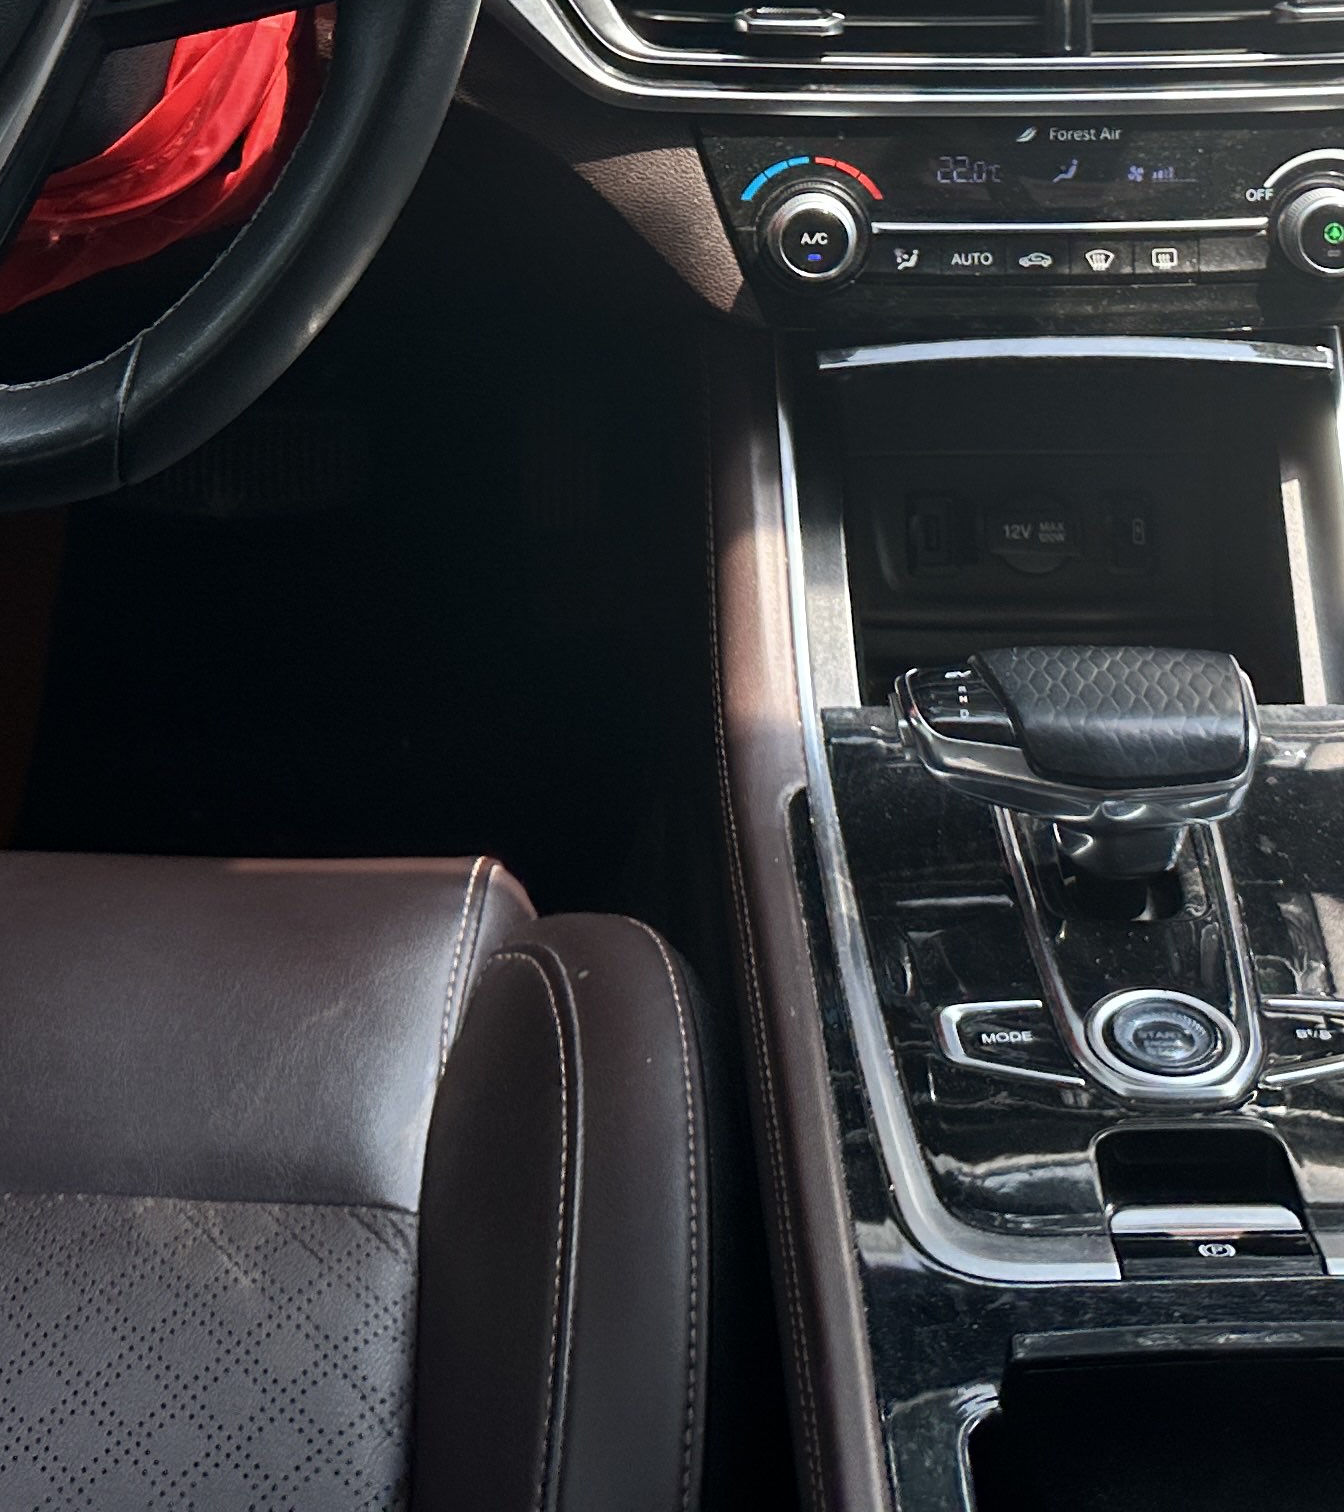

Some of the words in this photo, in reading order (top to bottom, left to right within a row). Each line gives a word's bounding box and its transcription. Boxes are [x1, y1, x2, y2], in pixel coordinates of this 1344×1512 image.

[1049, 127, 1097, 141] Forest
[1100, 127, 1123, 140] Air
[1245, 188, 1274, 202] OFF
[800, 232, 829, 245] A/C
[951, 252, 994, 267] AUTO
[1003, 523, 1032, 540] 12V
[981, 1031, 1033, 1045] MODE
